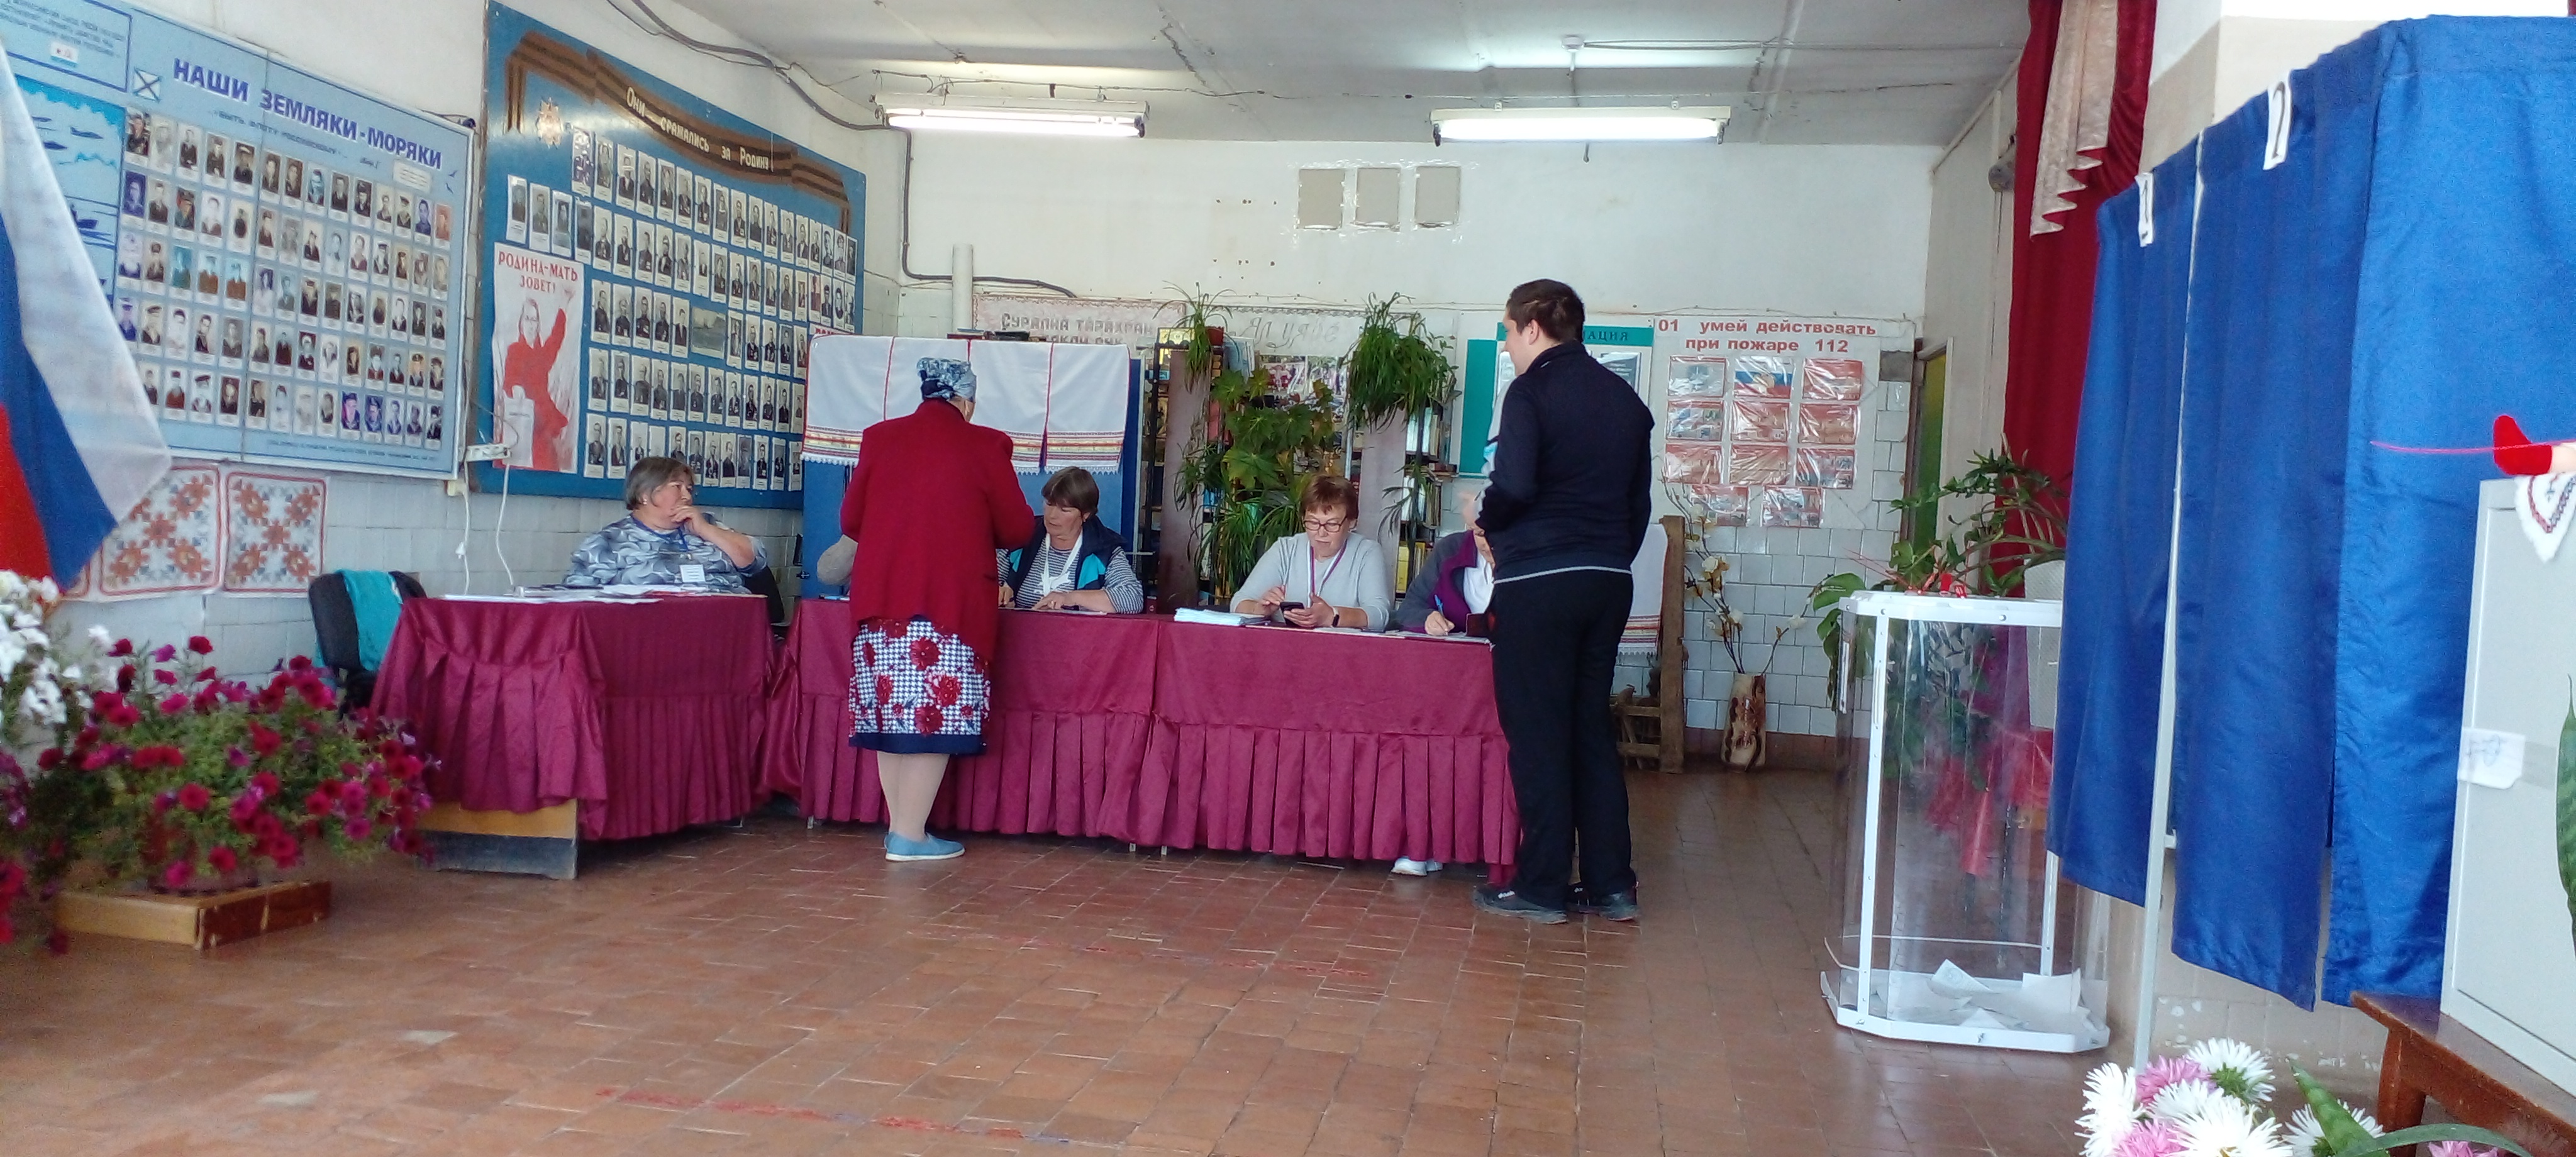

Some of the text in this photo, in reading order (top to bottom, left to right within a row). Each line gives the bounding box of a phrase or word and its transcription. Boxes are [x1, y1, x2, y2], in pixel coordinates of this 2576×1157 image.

[174, 57, 249, 103] НАШИ
[2272, 80, 2286, 160] 2
[519, 275, 555, 294] ЗОВЕТ!
[1583, 330, 1628, 341] АЦИЯ
[1658, 319, 1877, 335] 01 умей действовать
[1685, 338, 1848, 353] при пожаре 112
